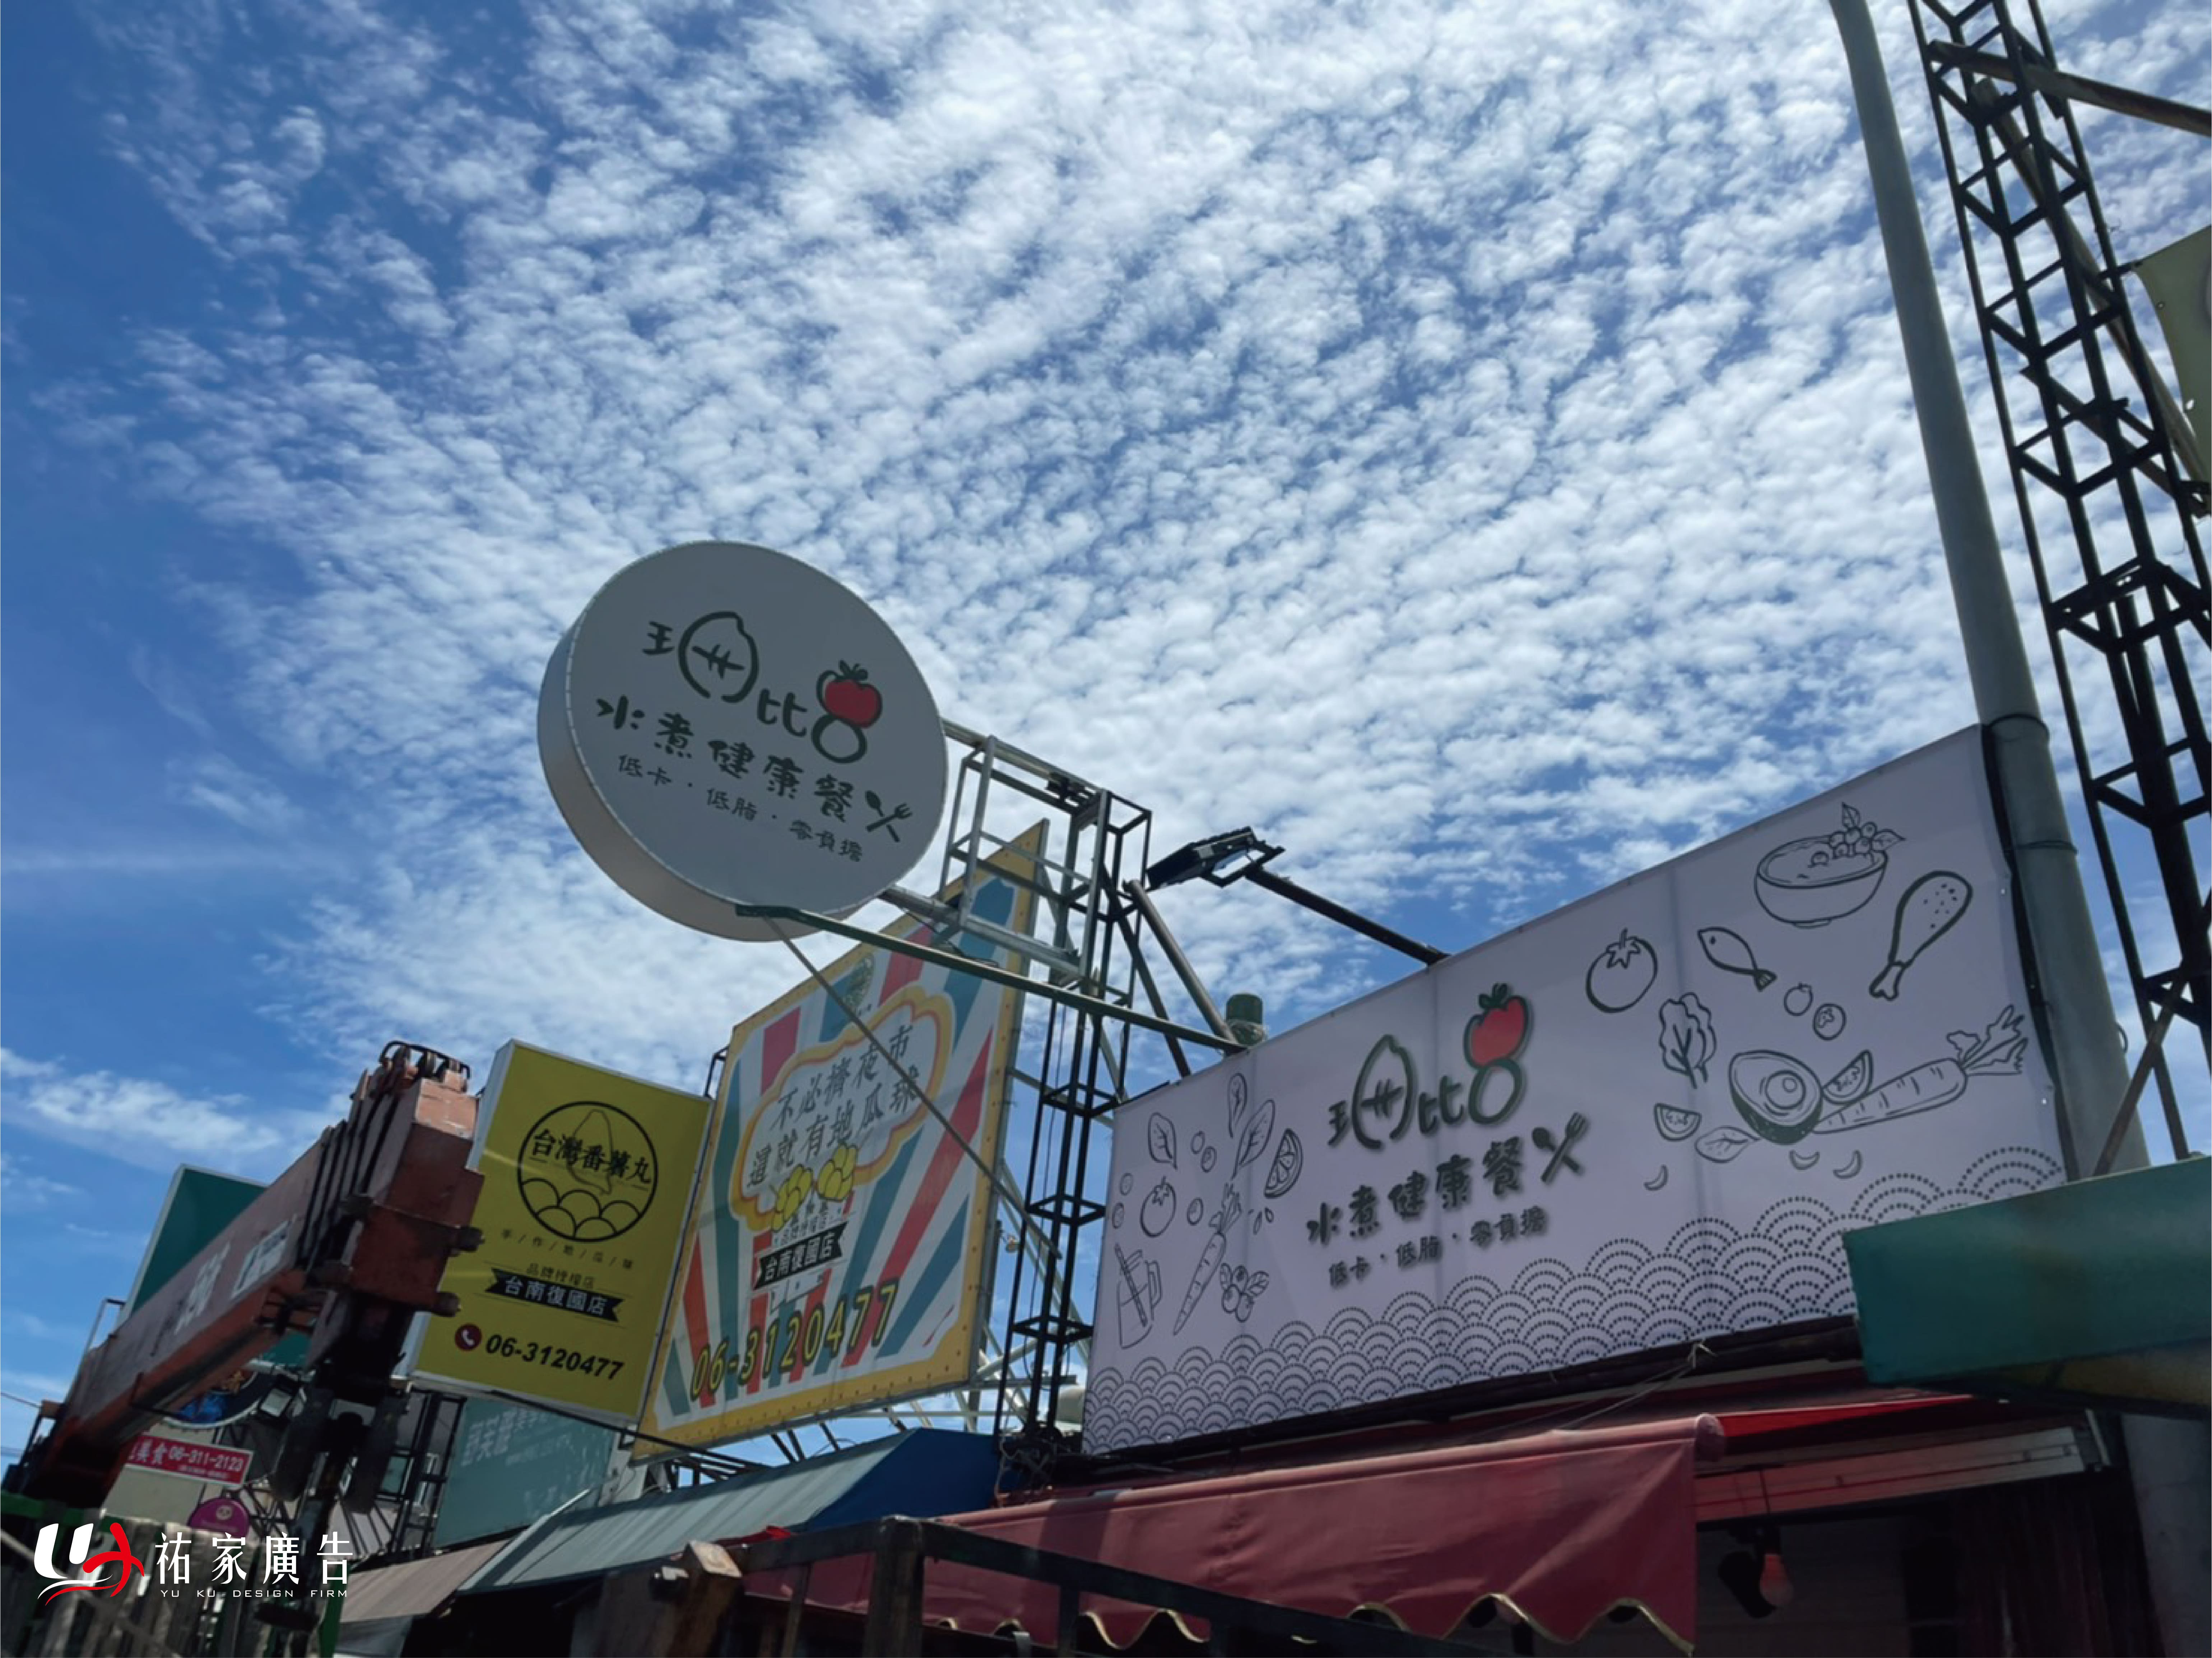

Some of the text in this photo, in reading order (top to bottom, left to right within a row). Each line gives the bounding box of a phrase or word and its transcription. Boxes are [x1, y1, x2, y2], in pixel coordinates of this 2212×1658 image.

[597, 695, 854, 822] 水煮健康餐
[533, 1128, 651, 1184] 台灣番薯丸
[1307, 1136, 1524, 1245] 水煮健康餐
[505, 1275, 608, 1316] 台南復國店
[486, 1333, 624, 1380] 06-3120477
[690, 1277, 899, 1401] 06-3120477
